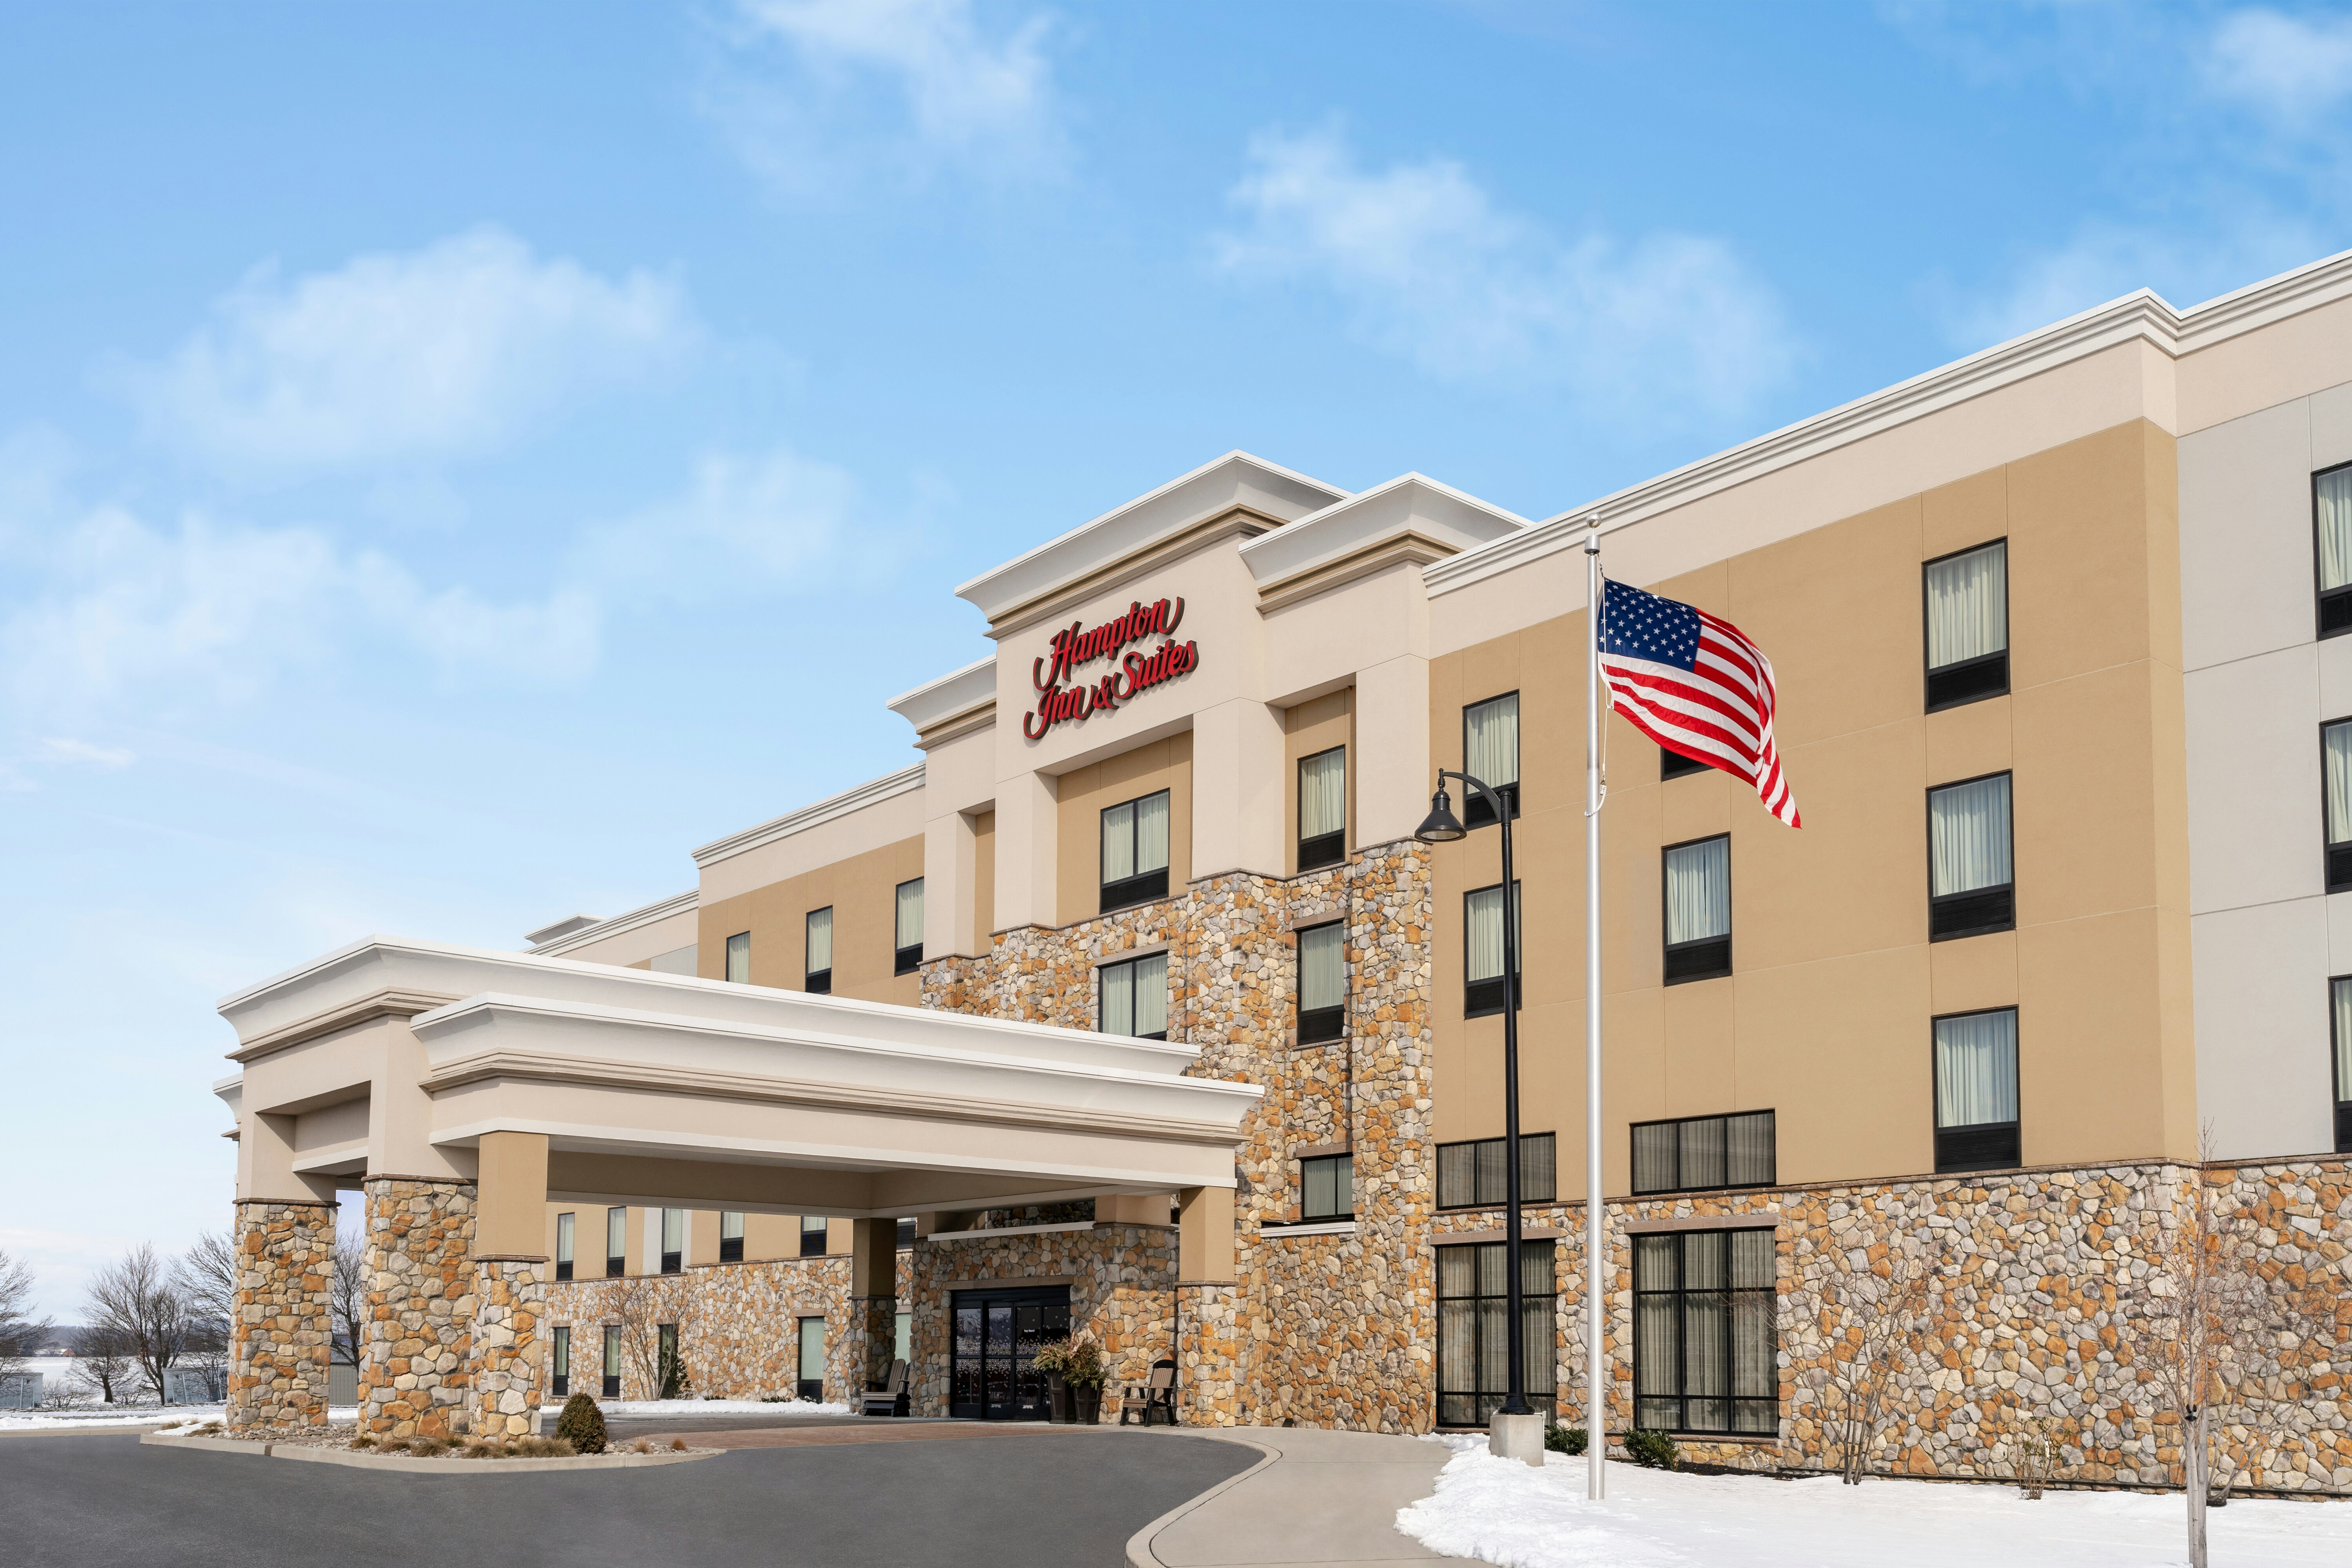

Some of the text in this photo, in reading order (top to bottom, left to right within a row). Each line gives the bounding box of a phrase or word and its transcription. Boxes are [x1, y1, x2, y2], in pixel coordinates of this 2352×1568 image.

[1024, 639, 1199, 739] Inn & Suites
[1033, 597, 1185, 691] Hampton
